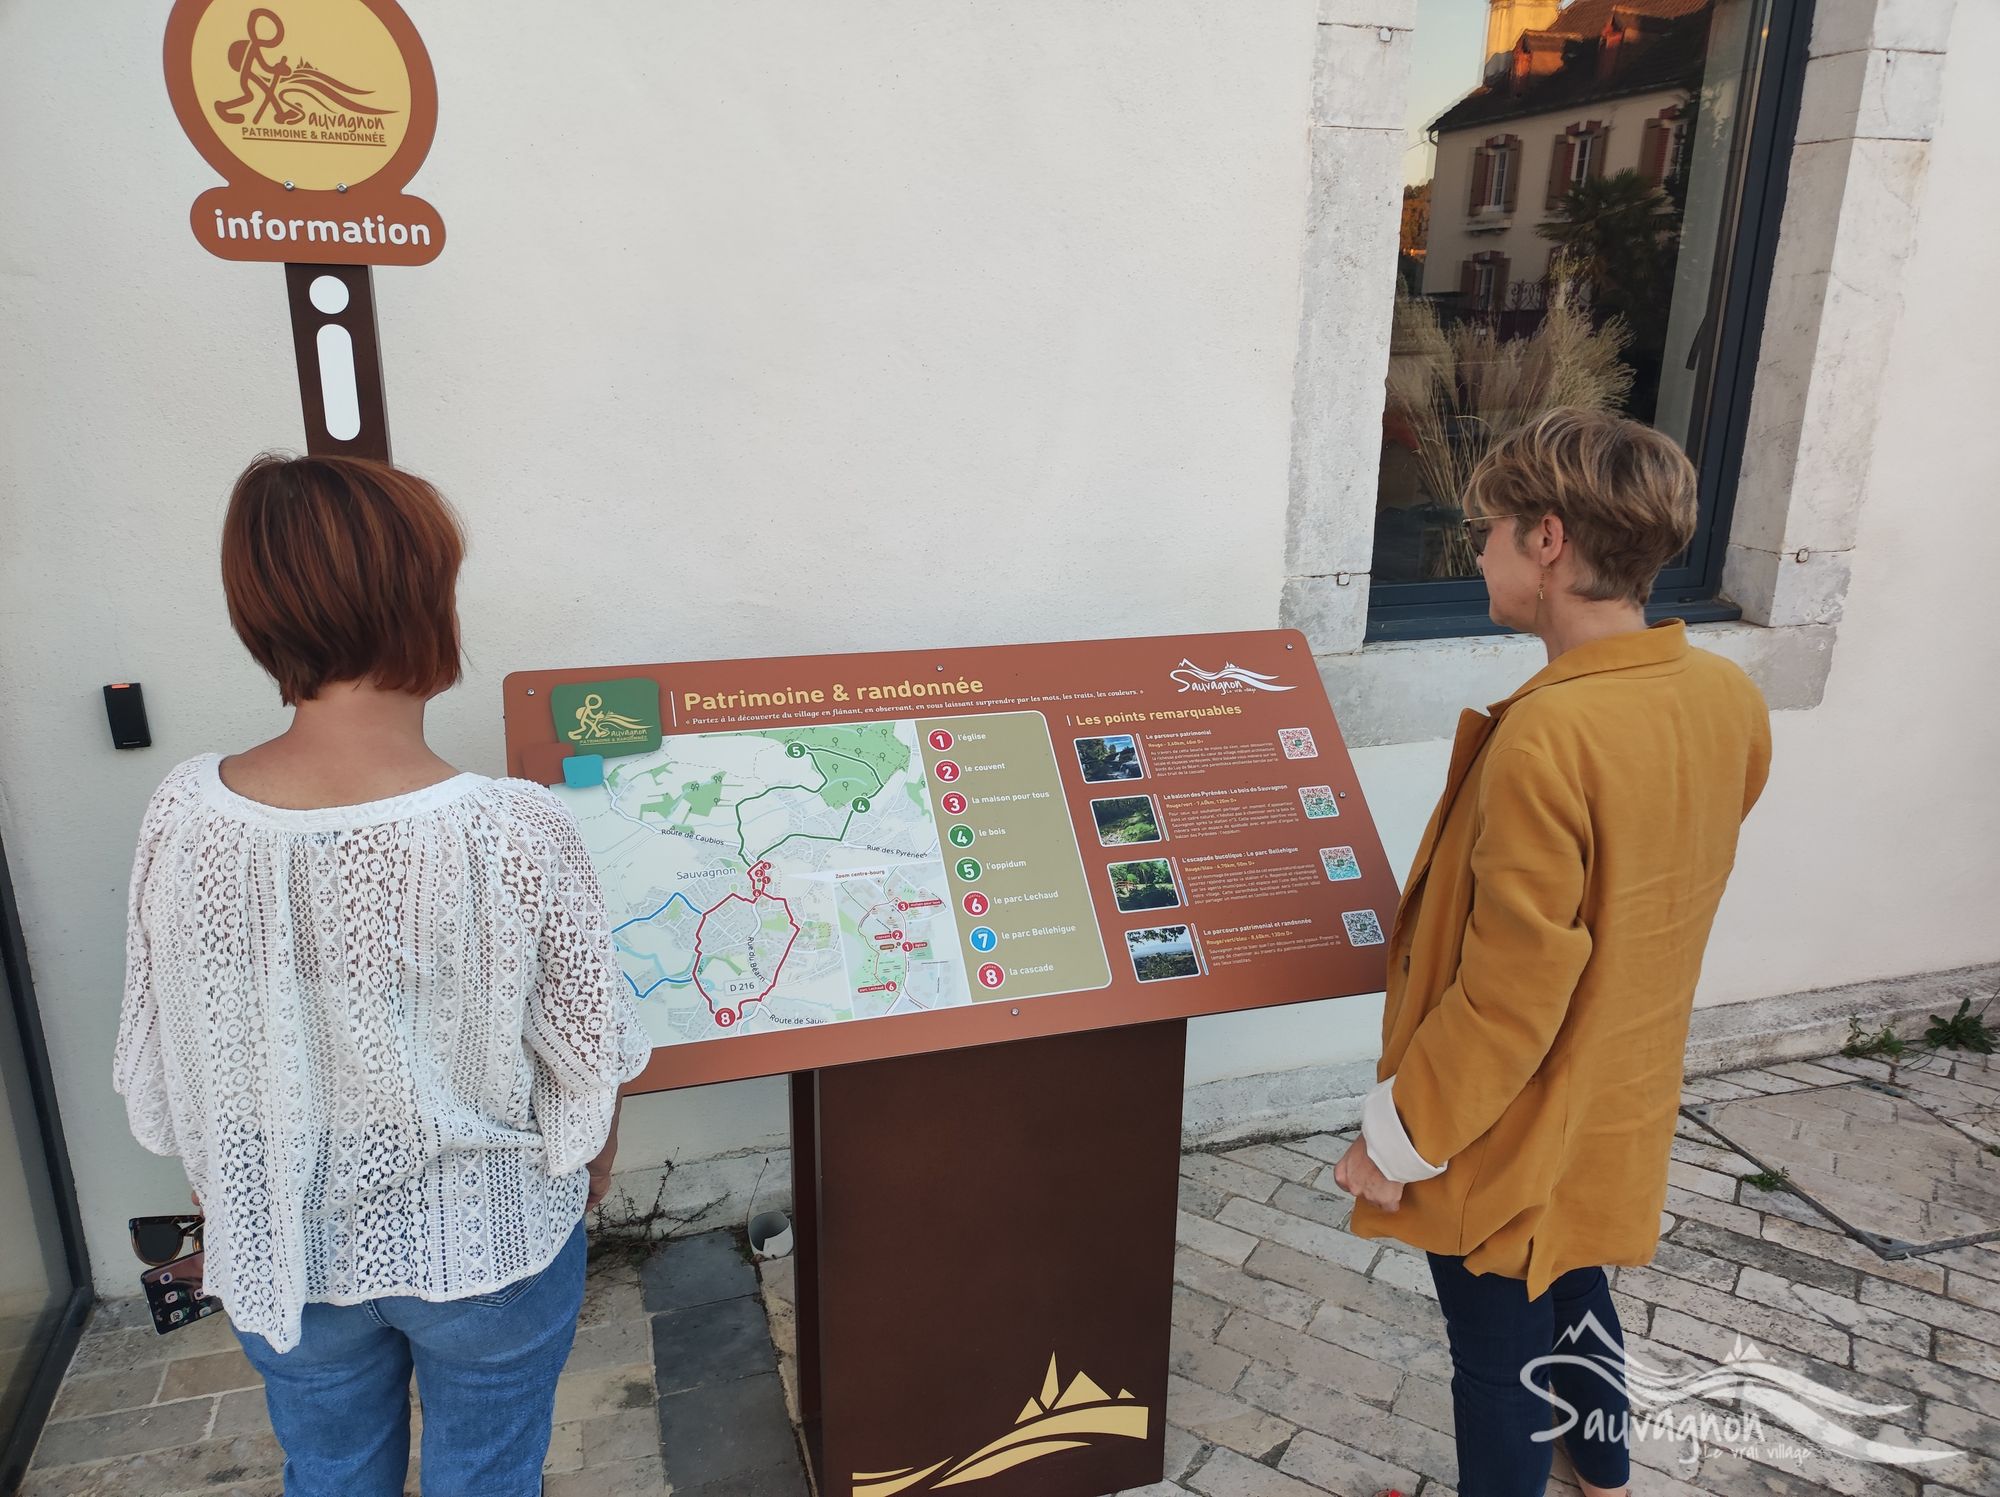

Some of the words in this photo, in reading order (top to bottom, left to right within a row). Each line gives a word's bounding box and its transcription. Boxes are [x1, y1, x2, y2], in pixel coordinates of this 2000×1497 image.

[278, 88, 385, 133] Sauvagnon
[242, 126, 308, 140] PATRIMOINE
[310, 130, 318, 140] &
[320, 131, 385, 144] RANDONNÉE
[214, 208, 431, 246] information
[1169, 668, 1243, 696] Sauvagnon
[684, 687, 826, 711] Patrimoine
[832, 683, 850, 703] &
[856, 677, 984, 701] randonnée
[692, 716, 719, 725] Partez
[720, 714, 727, 723] à
[727, 714, 736, 722] la
[737, 711, 781, 722] découverte
[782, 711, 793, 719] du
[794, 708, 820, 720] village
[832, 706, 863, 717] flânant,
[875, 703, 915, 713] observant,
[926, 702, 943, 710] vous
[944, 700, 975, 709] laissant
[975, 697, 1016, 708] surprendre
[1016, 696, 1030, 706] par
[1030, 695, 1042, 703] les
[1042, 693, 1062, 702] mots,
[1062, 693, 1073, 701] les
[1073, 691, 1096, 700] traits,
[1097, 690, 1107, 698] les
[1107, 688, 1139, 697] couleurs.
[1075, 713, 1102, 726] Les
[1104, 711, 1146, 727] points
[1149, 704, 1243, 722] remarquables
[935, 734, 945, 748] 1
[957, 733, 986, 742] l'église
[1154, 732, 1179, 741] parcours
[1179, 729, 1213, 739] patrimonial
[792, 746, 801, 757] 5
[942, 765, 954, 779] 2
[974, 763, 1006, 771] couvent
[1171, 792, 1191, 800] balcon
[1201, 789, 1229, 799] Pyrénées
[1258, 784, 1288, 793] Sauvagnon
[857, 800, 866, 812] 4
[949, 797, 960, 812] 3
[981, 794, 1011, 803] maison
[1012, 793, 1031, 802] pour
[1032, 791, 1050, 799] tous
[661, 828, 683, 837] Route
[695, 834, 724, 846] Caubios
[956, 830, 968, 844] 4
[978, 829, 987, 837] le
[988, 827, 1007, 836] bois
[866, 844, 880, 852] Rue
[881, 847, 894, 855] des
[895, 849, 928, 859] Pyrénées
[1182, 854, 1214, 864] L'escapade
[1214, 852, 1243, 862] bucolique
[1254, 850, 1268, 858] parc
[1268, 847, 1299, 856] Bellehigue
[676, 866, 737, 880] Sauvagnon
[850, 869, 886, 878] centre-bourg
[963, 863, 975, 879] 5
[986, 860, 1027, 870] l'oppidum
[900, 902, 906, 911] 3
[971, 898, 983, 913] 6
[1004, 895, 1022, 905] parc
[1023, 890, 1059, 901] Lechaud
[1212, 927, 1239, 936] parcours
[1239, 923, 1274, 934] patrimonial
[1281, 918, 1312, 927] randonnée
[894, 932, 901, 940] 2
[977, 933, 989, 949] 7
[1001, 932, 1010, 940] le
[1012, 930, 1030, 940] parc
[1032, 924, 1077, 937] Bellehigue
[748, 951, 756, 961] du
[750, 962, 766, 983] Béarn
[985, 969, 998, 985] 8
[1009, 968, 1018, 976] la
[1020, 963, 1055, 975] cascade
[730, 984, 737, 992] D
[739, 982, 755, 991] 216
[888, 982, 895, 991] 6
[720, 1012, 730, 1025] 8
[769, 1014, 792, 1025] Route
[794, 1017, 803, 1025] de
